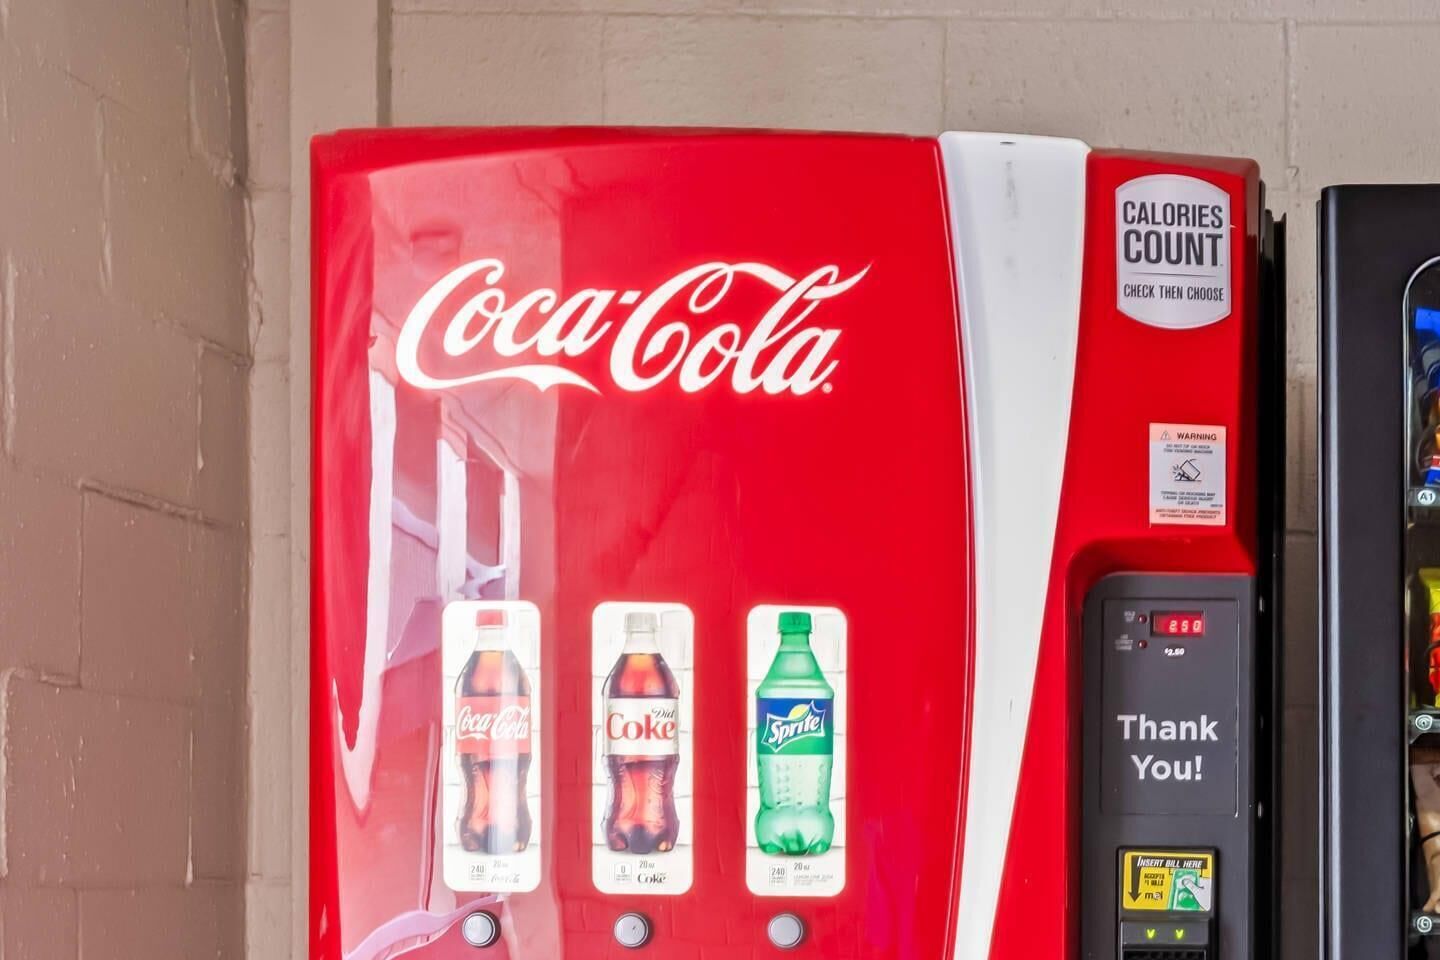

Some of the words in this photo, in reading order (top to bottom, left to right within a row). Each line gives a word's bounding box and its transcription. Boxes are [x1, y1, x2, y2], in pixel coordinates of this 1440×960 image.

[1123, 201, 1223, 229] CALORIES
[1123, 229, 1224, 267] COUNT
[1124, 284, 1155, 299] CHECK
[1159, 285, 1183, 300] THEN
[1187, 286, 1224, 302] CHOOSE
[396, 258, 874, 395] Coca-Cola
[1177, 432, 1217, 441] WARNING
[457, 704, 530, 741] Coca-Cola
[606, 712, 676, 741] Coke
[652, 707, 675, 719] Diet
[768, 713, 822, 744] Sprite
[1117, 714, 1219, 741] Thank
[1131, 754, 1203, 781] You!
[1137, 855, 1165, 868] INSERT
[1165, 858, 1181, 868] BILL
[1183, 860, 1203, 869] HERE
